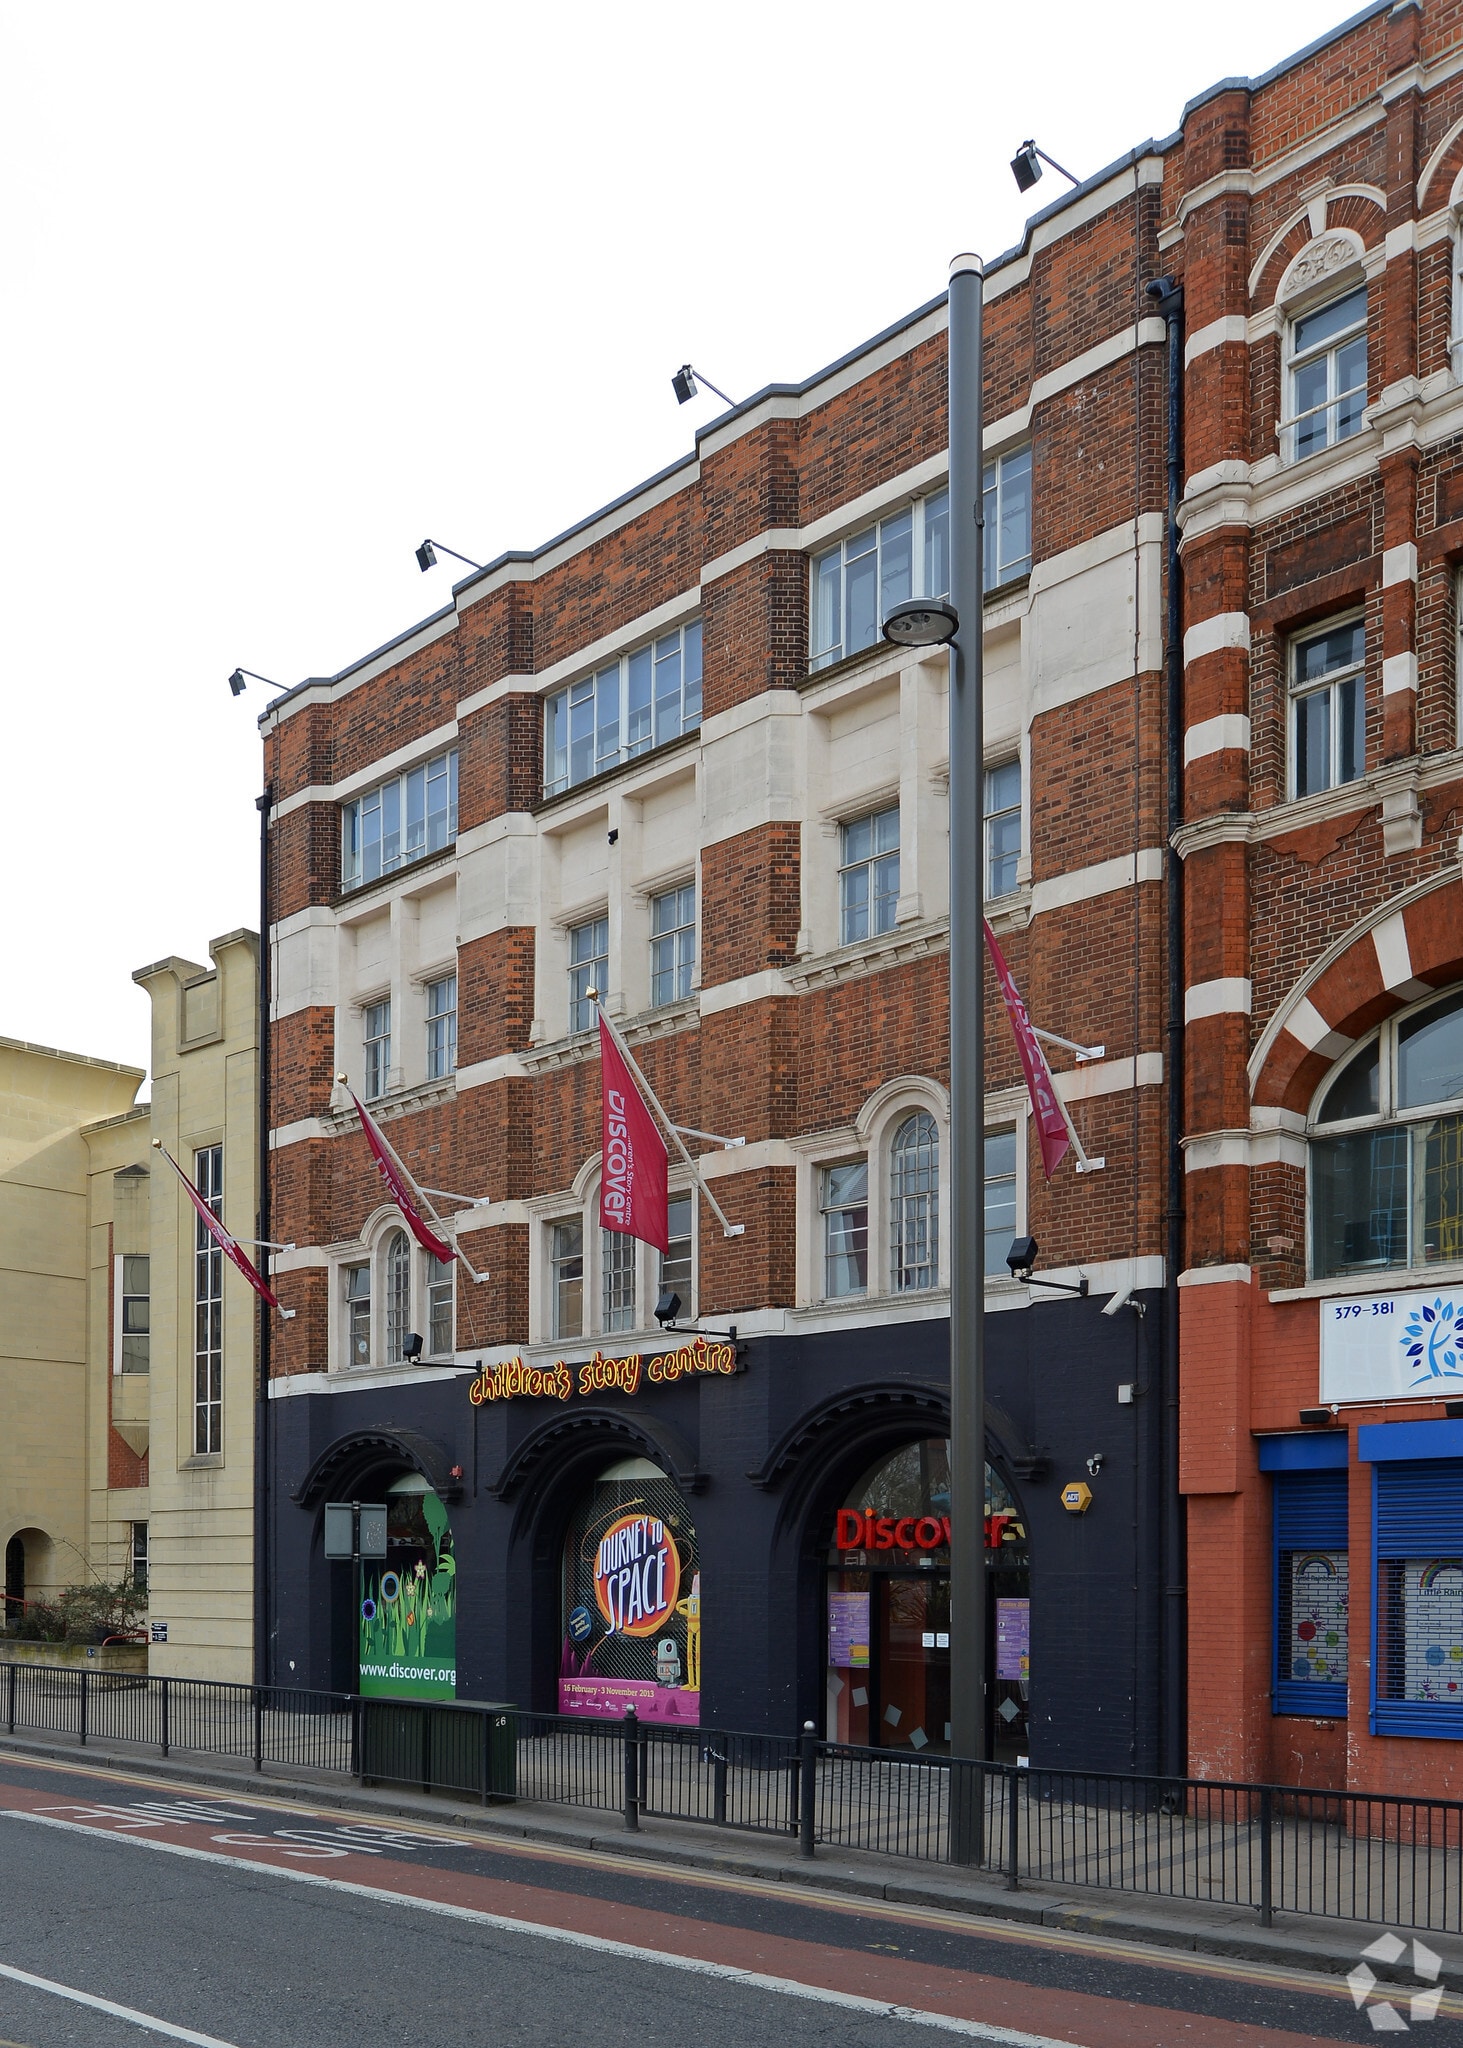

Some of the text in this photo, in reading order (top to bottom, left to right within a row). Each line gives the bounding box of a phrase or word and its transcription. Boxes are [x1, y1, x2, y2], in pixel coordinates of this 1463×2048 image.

[626, 1171, 634, 1195] Story
[1335, 1302, 1394, 1319] 379-381
[469, 1336, 736, 1405] children's story centre
[1066, 1493, 1079, 1501] ADT
[837, 1507, 1012, 1549] Discor
[596, 1516, 663, 1579] JOURNEY TO
[605, 1547, 668, 1635] SPACE
[360, 1663, 456, 1686] www.discover.org
[564, 1684, 571, 1692] 16
[571, 1684, 597, 1695] February
[606, 1687, 637, 1697] November
[640, 1689, 655, 1697] 2013
[210, 1824, 473, 1858] BUS
